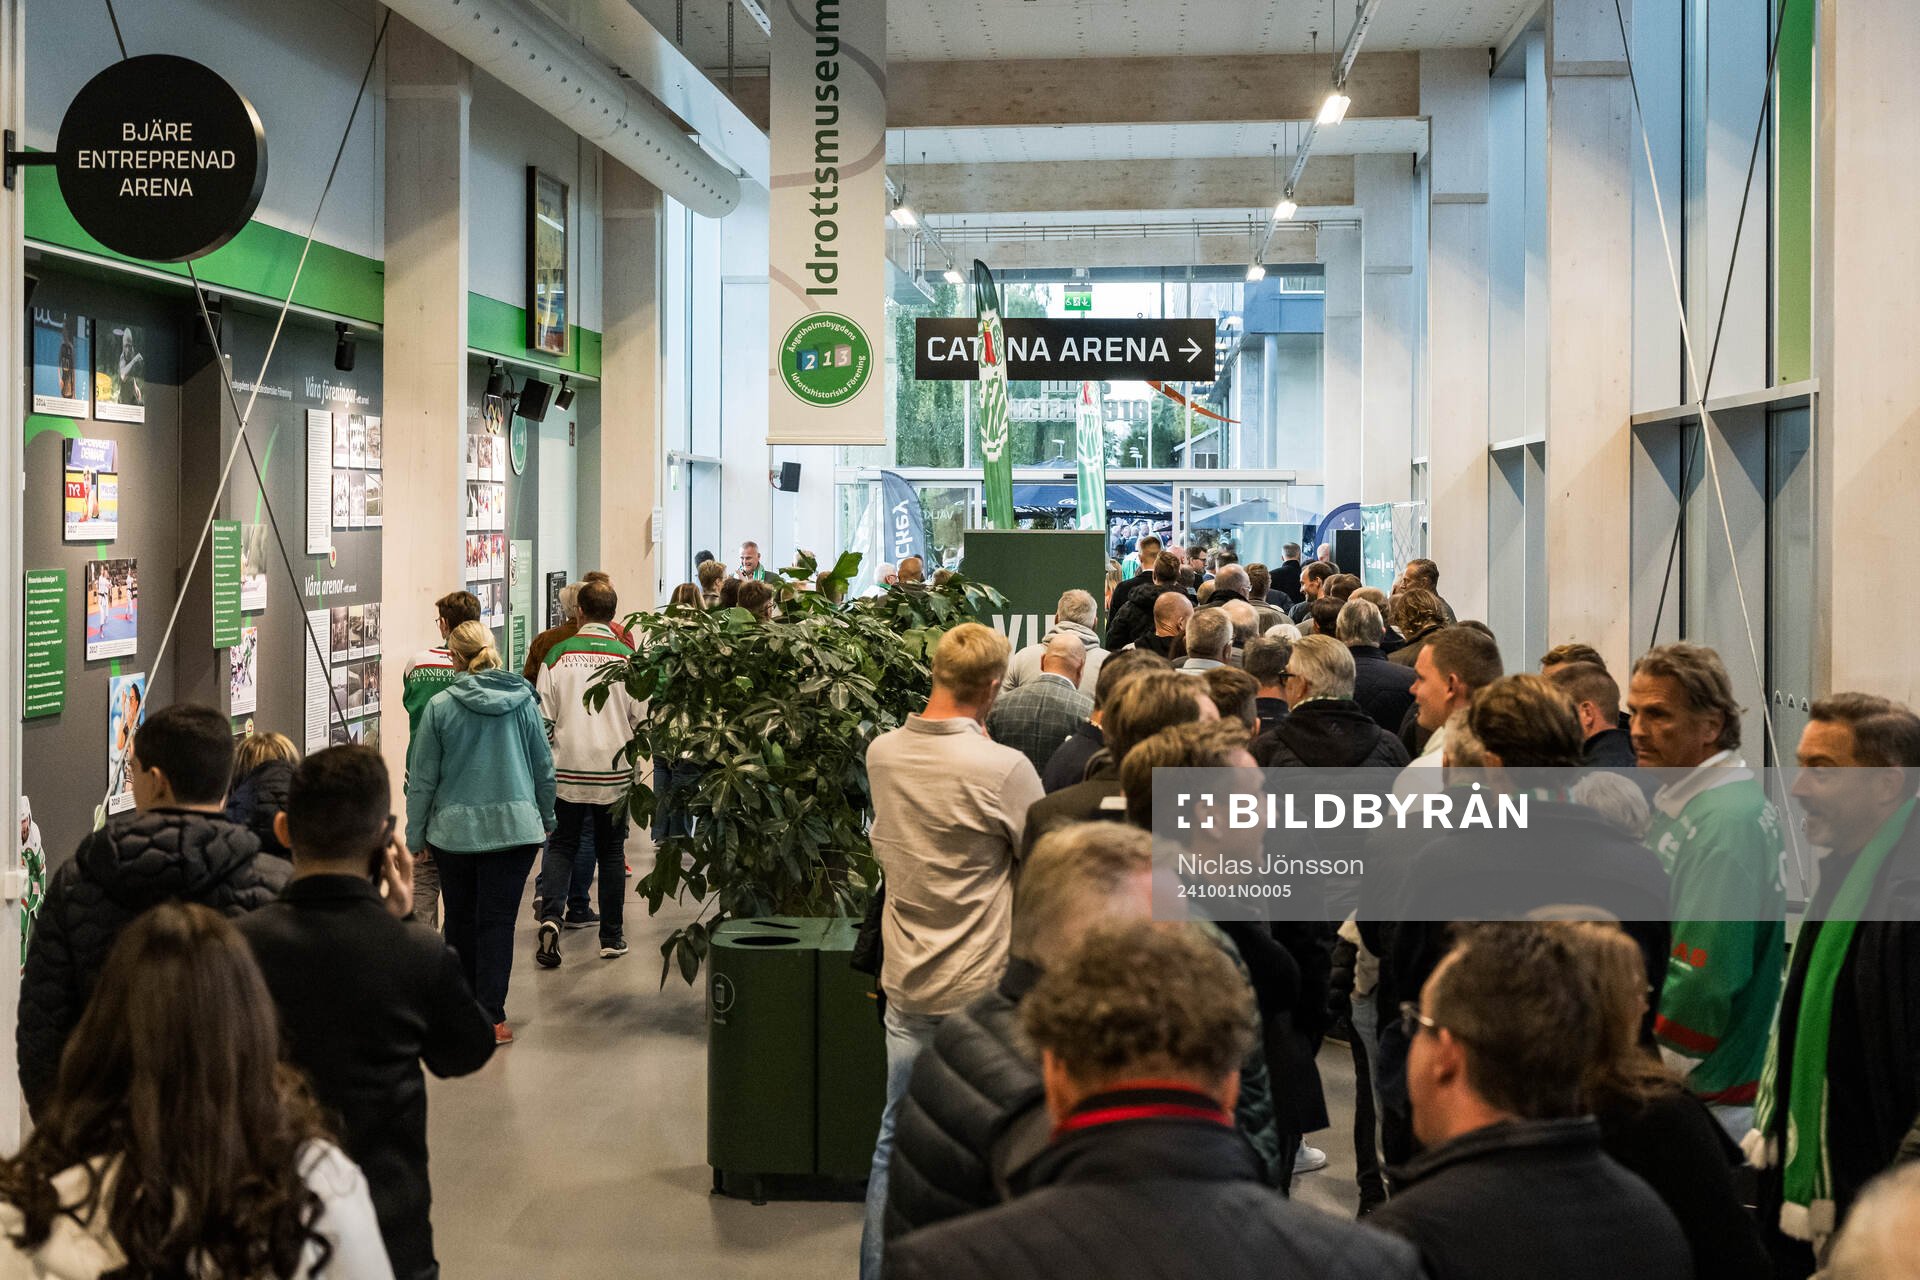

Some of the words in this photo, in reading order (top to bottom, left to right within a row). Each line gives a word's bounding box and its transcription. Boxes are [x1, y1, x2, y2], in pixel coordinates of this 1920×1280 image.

[122, 118, 193, 142] BJÄRE
[78, 149, 236, 170] ENTREPRENAD
[805, 0, 840, 296] Idrottsmuseum
[119, 177, 194, 197] ARENA
[927, 336, 1052, 362] CATNA
[1059, 337, 1170, 362] ARENA
[791, 372, 849, 399] Idrottshistoriska
[846, 355, 867, 389] Förening
[305, 376, 321, 399] Våra
[321, 379, 357, 408] föreningar
[68, 484, 81, 497] TYR
[305, 574, 321, 597] Våra
[321, 579, 344, 596] arenor
